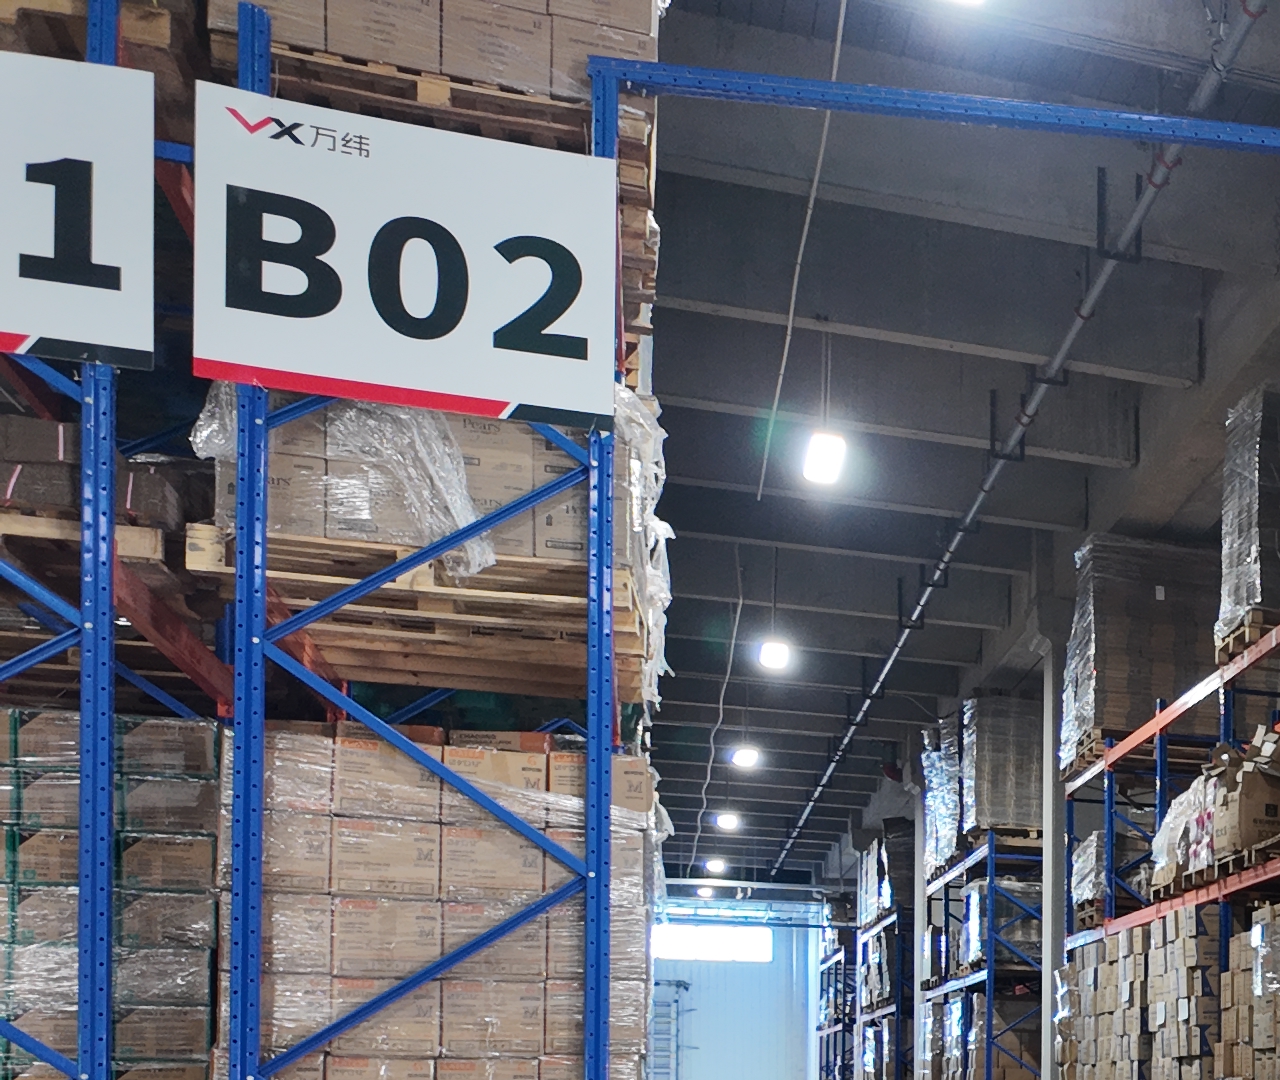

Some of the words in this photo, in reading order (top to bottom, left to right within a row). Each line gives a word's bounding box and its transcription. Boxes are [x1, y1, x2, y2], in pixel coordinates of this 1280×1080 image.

[310, 125, 370, 158] 万纬
[225, 184, 589, 361] B02
[462, 418, 500, 433] Pears
